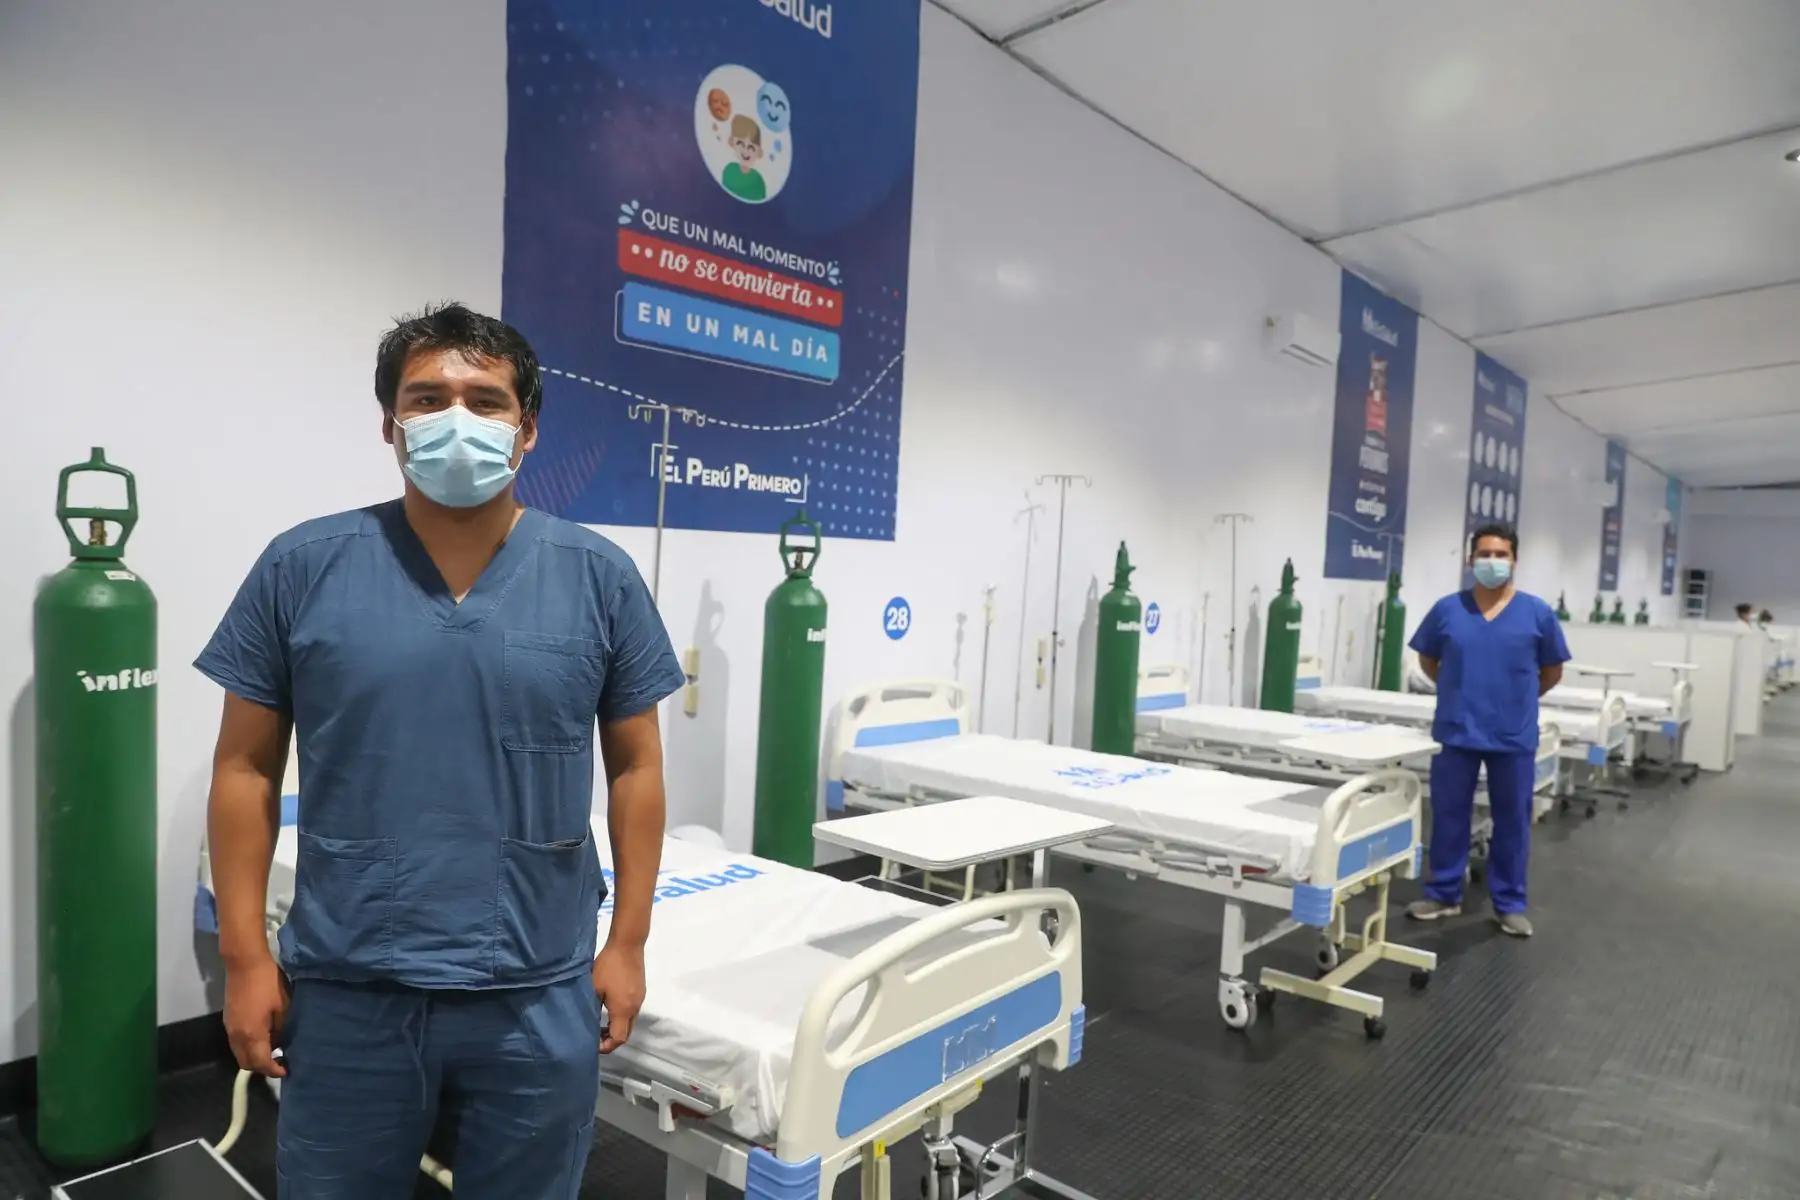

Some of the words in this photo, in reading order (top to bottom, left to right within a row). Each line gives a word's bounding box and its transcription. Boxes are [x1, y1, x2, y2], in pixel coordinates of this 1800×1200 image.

[758, 0, 832, 39] alud
[641, 208, 680, 234] QUE
[684, 220, 708, 244] UN
[713, 230, 746, 254] MAL
[750, 241, 826, 278] MOMENTO
[659, 248, 689, 272] no
[694, 258, 719, 281] se
[722, 267, 813, 308] convierta
[638, 302, 671, 327] EN
[687, 313, 719, 338] UN
[733, 324, 780, 352] MAL
[792, 336, 828, 362] DÍA
[886, 606, 909, 631] 28
